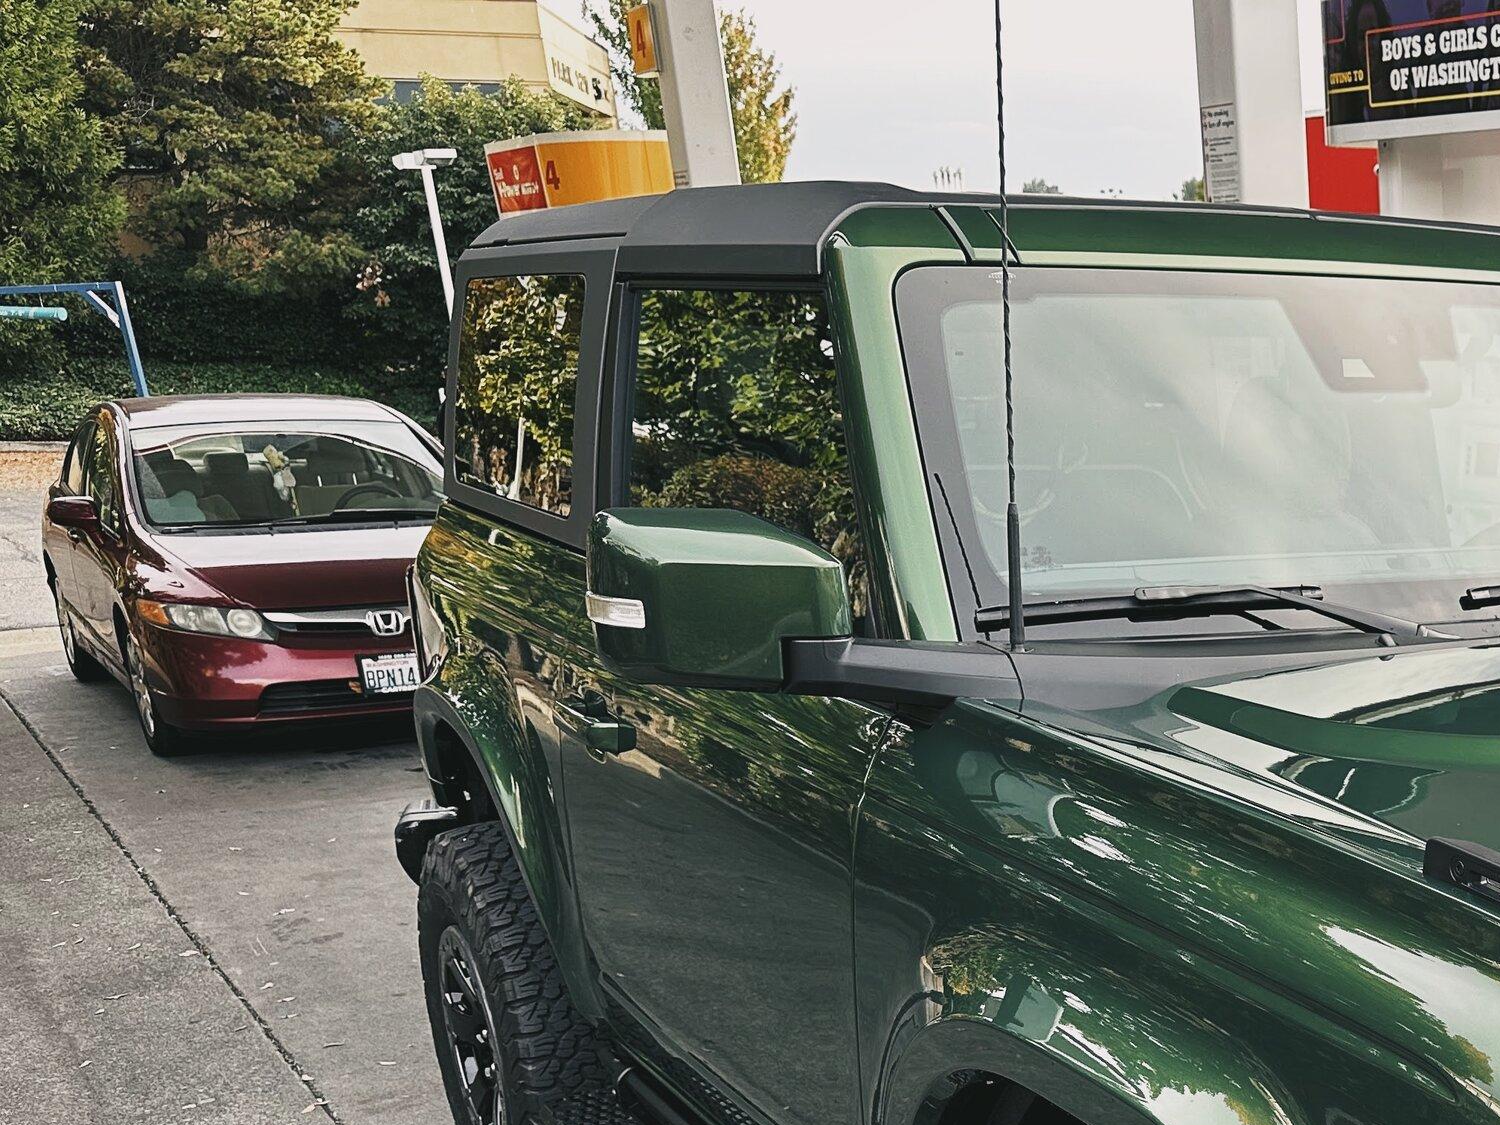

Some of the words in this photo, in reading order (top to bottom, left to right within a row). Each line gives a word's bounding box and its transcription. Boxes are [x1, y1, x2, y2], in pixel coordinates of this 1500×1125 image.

[636, 20, 646, 58] 4
[1381, 36, 1422, 62] BOYS
[1424, 35, 1436, 56] &
[1439, 27, 1487, 54] GIRLS
[1353, 69, 1364, 81] TO
[1390, 67, 1409, 91] OF
[546, 160, 560, 190] 4
[366, 667, 417, 689] BPN14
